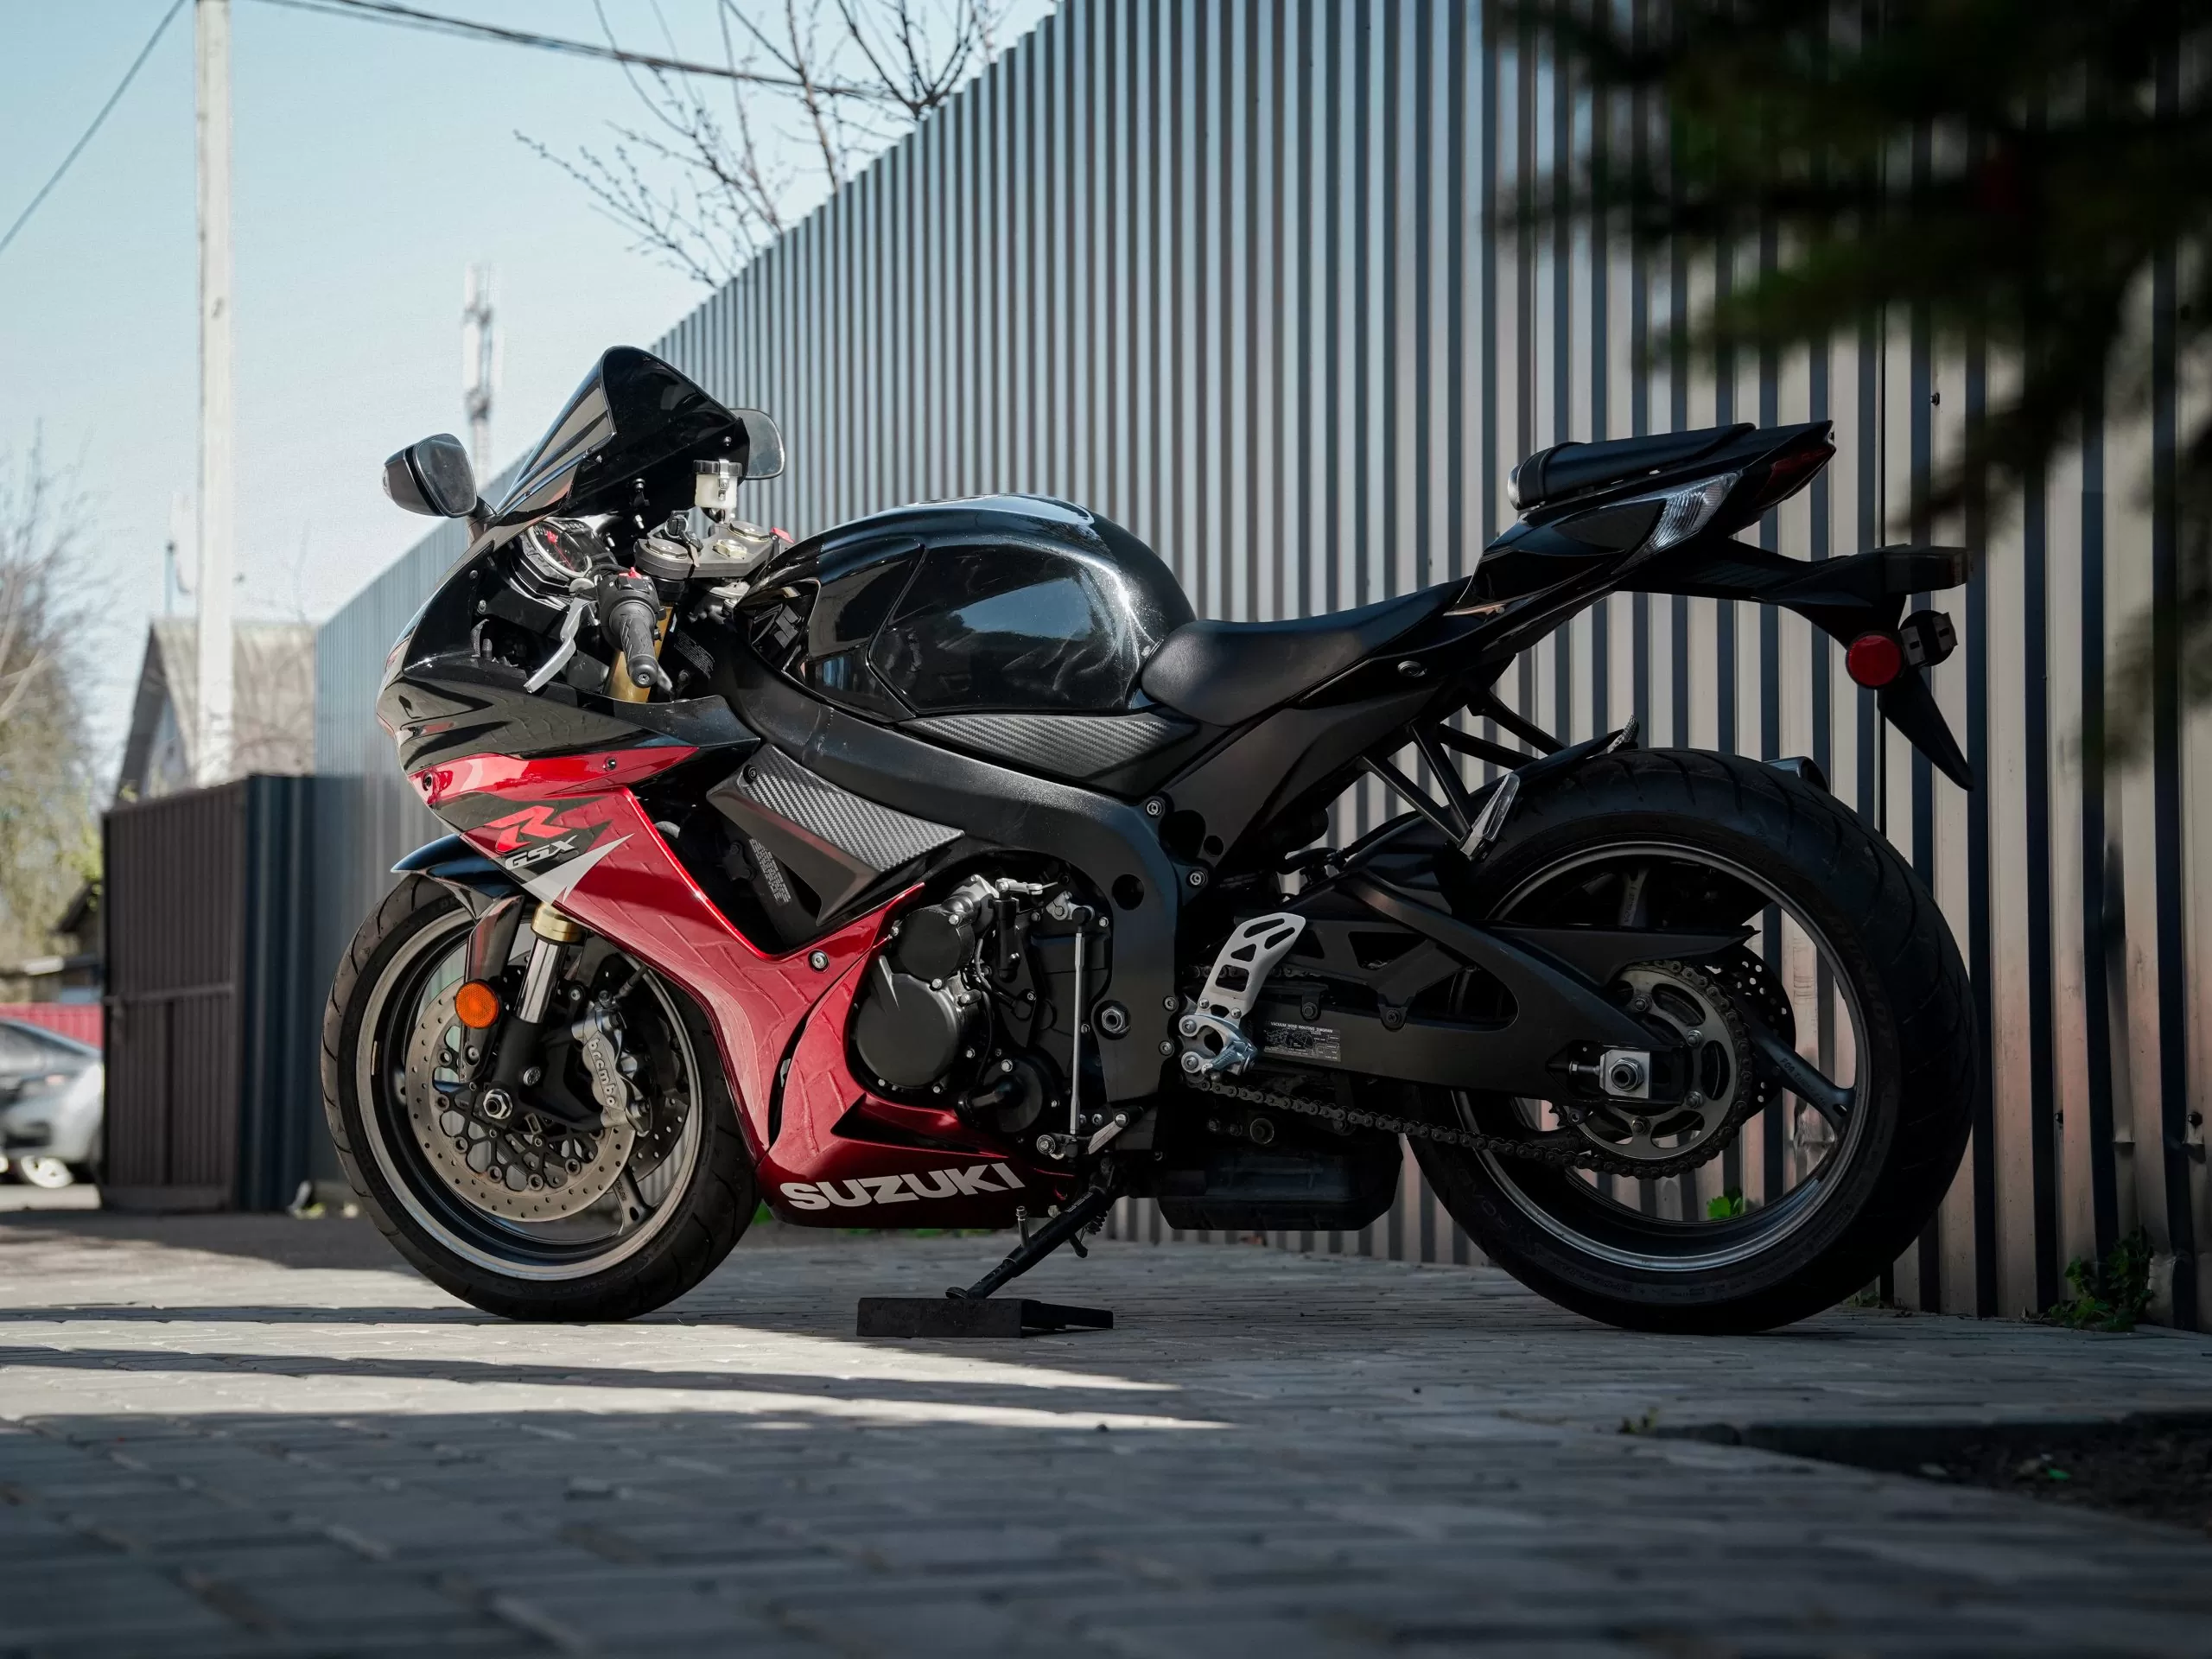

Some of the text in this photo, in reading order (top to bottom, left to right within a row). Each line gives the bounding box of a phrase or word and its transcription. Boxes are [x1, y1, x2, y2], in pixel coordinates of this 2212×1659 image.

[505, 835, 579, 870] GSX
[588, 1039, 615, 1106] brembo
[779, 1162, 1026, 1210] SUZUKI
